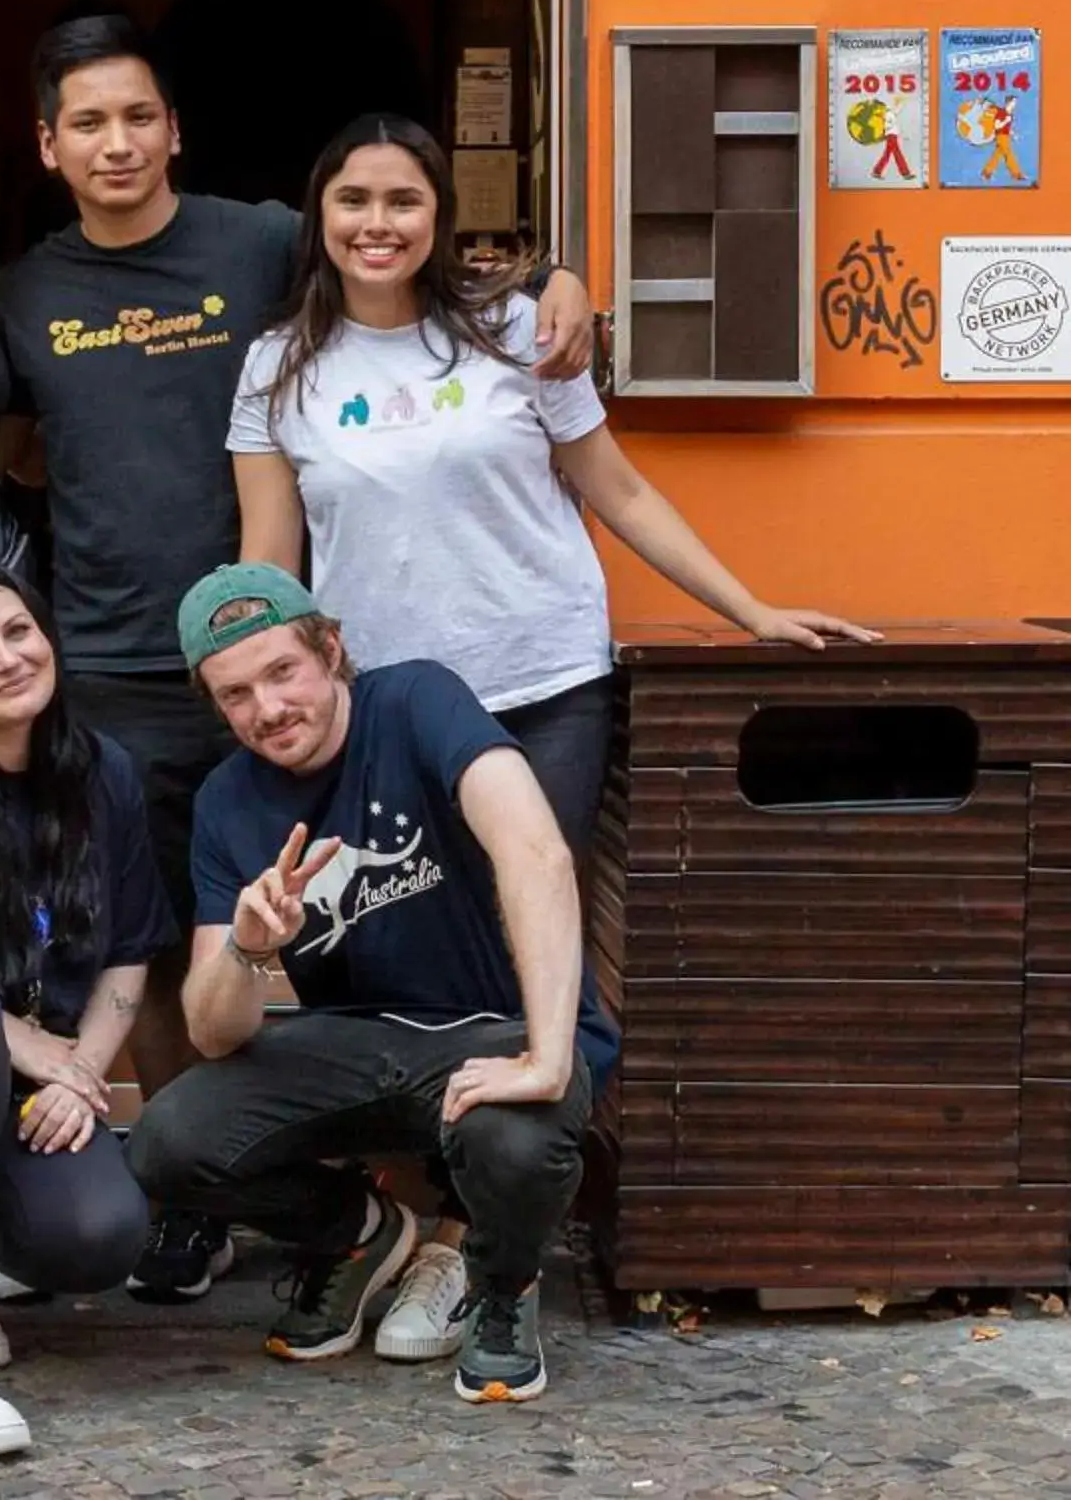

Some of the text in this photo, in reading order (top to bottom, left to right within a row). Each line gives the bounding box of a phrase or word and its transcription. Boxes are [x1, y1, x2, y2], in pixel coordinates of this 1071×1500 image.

[845, 74, 916, 94] 2015
[954, 71, 1031, 92] 2014
[967, 263, 1049, 304] BACKPACKER
[966, 292, 1060, 331] GERMANY
[144, 331, 231, 356] Berlin Hostel
[984, 324, 1056, 357] NETWORK
[355, 856, 444, 912] Australia
